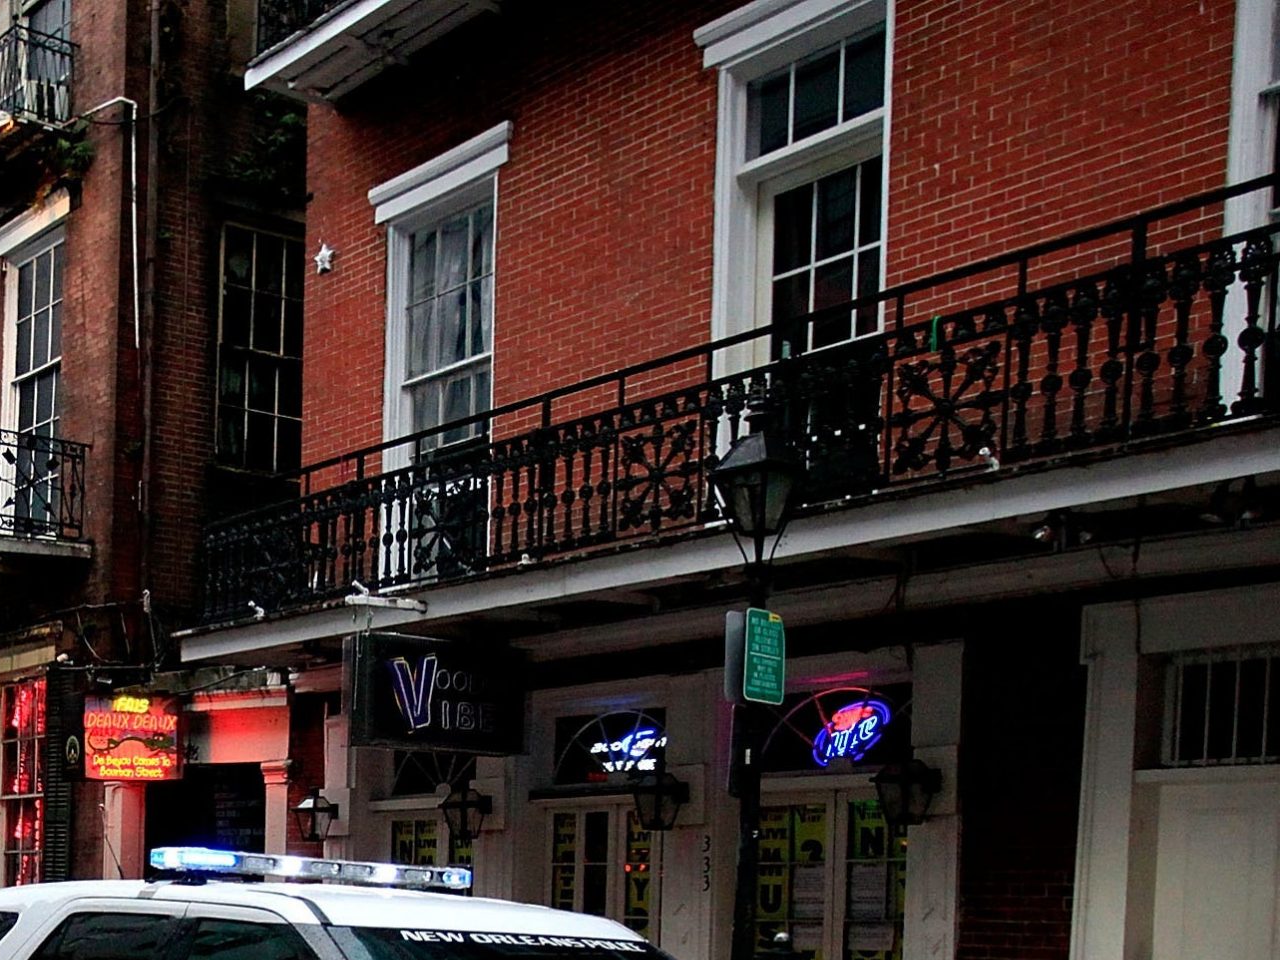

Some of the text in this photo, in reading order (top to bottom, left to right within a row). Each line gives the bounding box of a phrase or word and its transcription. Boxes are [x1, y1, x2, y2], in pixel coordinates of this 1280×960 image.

[86, 713, 178, 731] DEAUX DEAUX
[400, 929, 465, 943] NEW
[470, 932, 581, 949] ORLEANS
